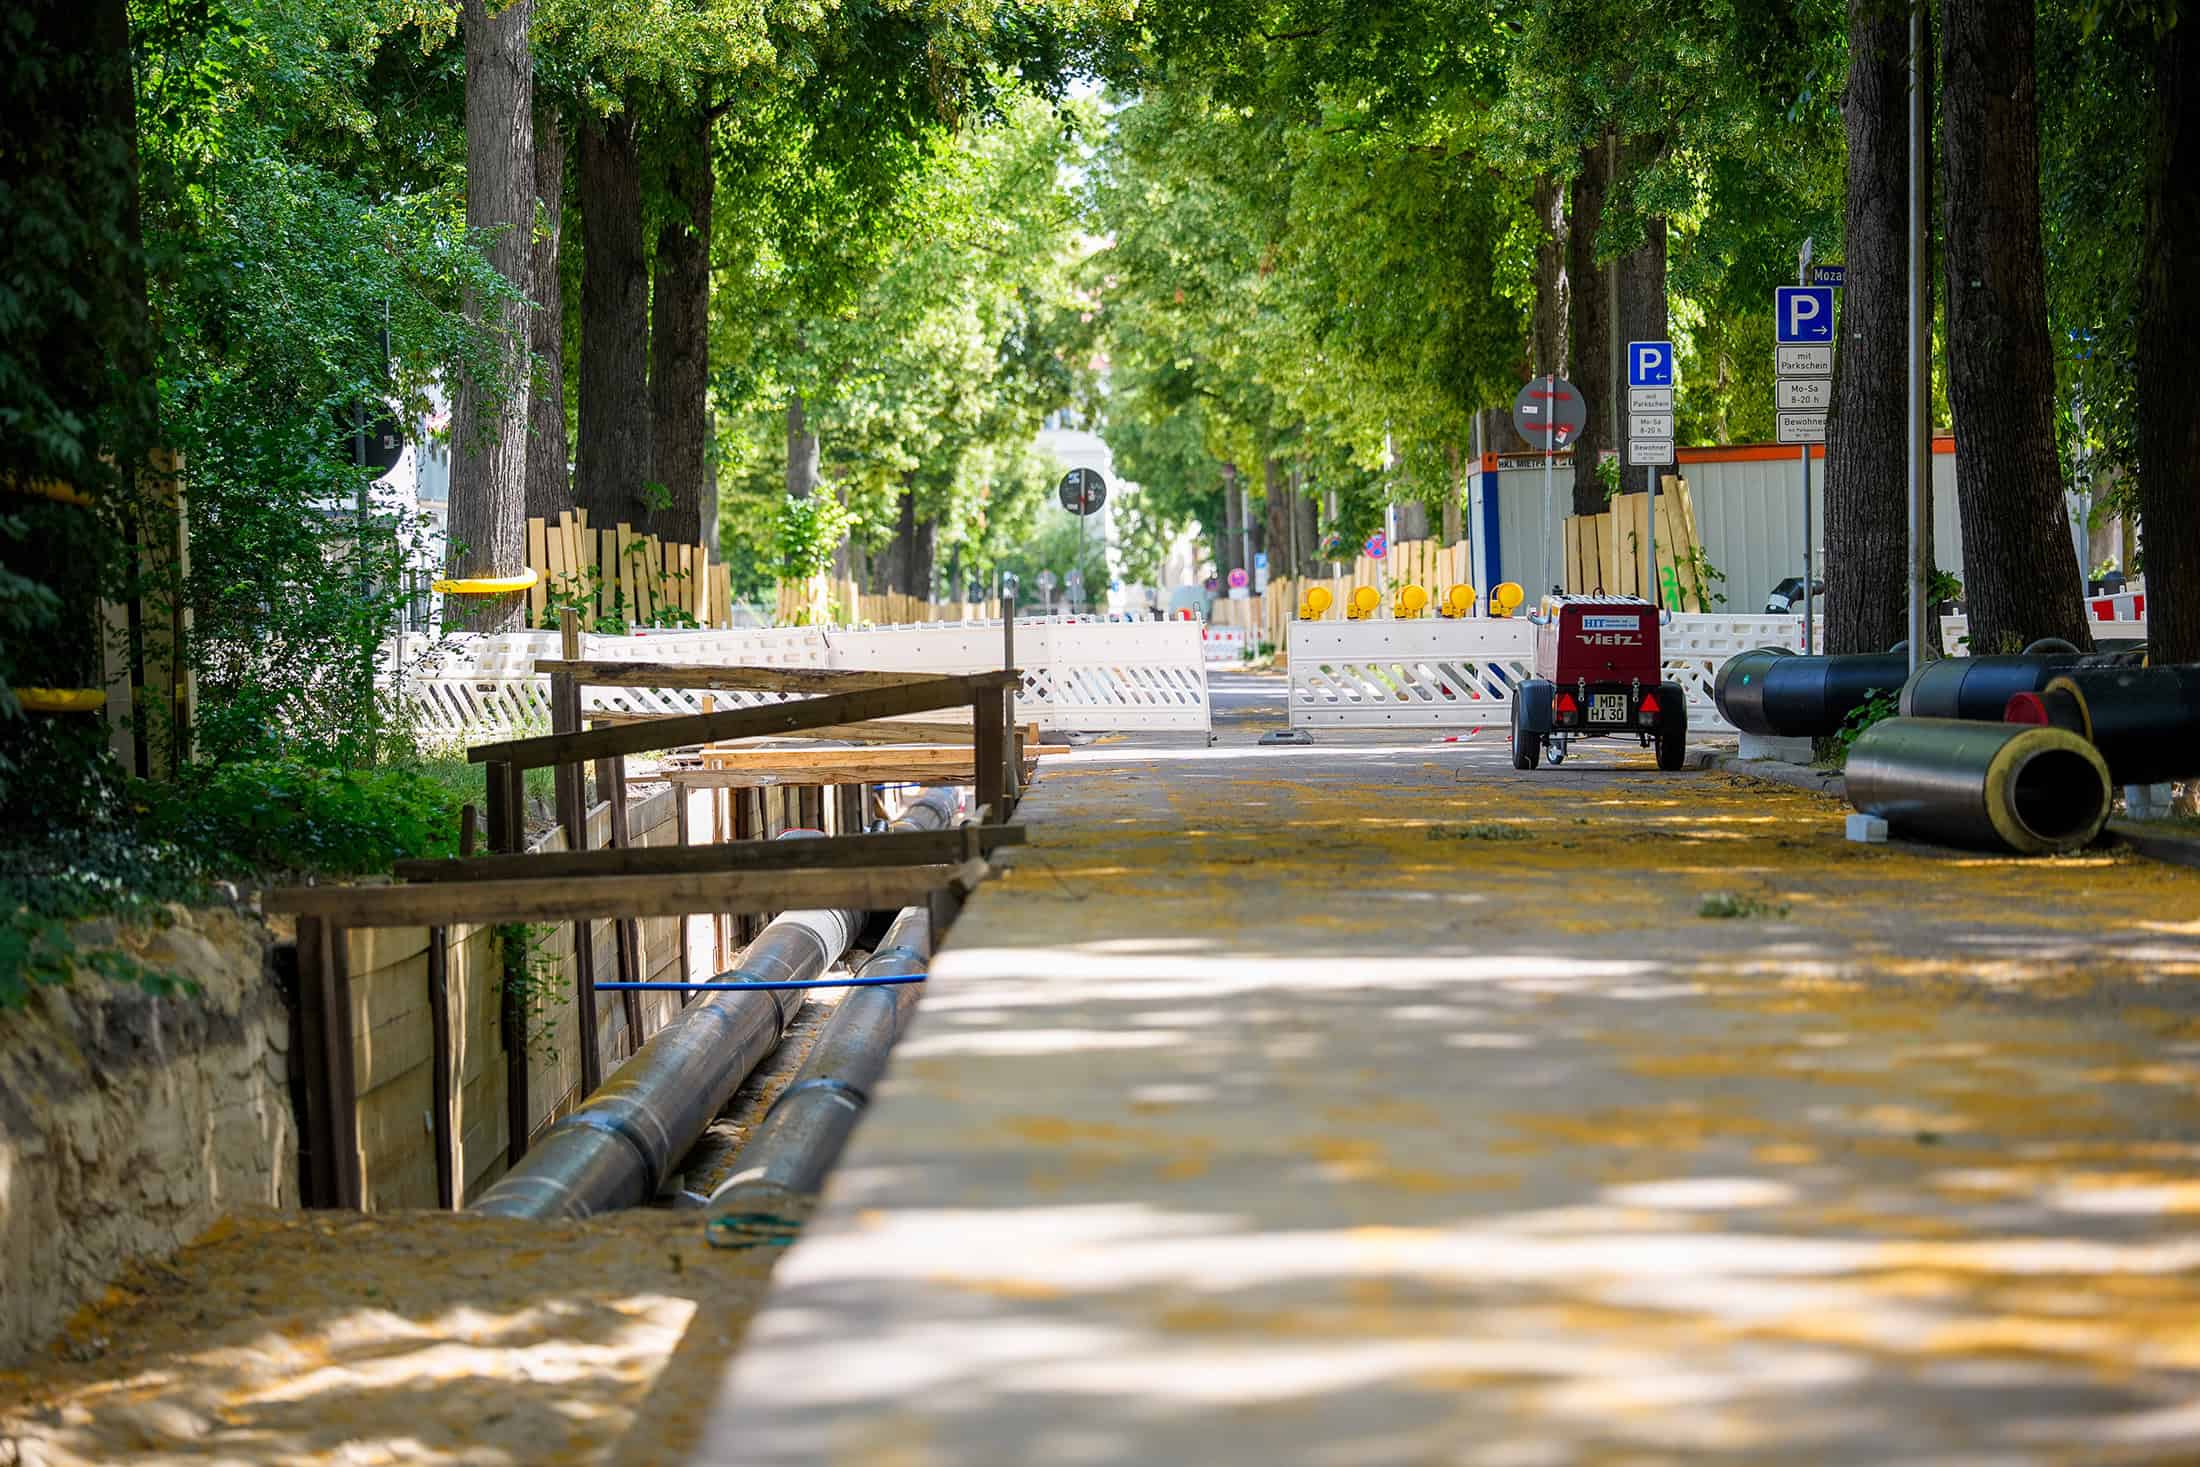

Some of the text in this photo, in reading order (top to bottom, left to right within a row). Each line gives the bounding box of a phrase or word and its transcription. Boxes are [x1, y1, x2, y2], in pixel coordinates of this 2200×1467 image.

[1791, 295, 1820, 336] P
[1797, 352, 1811, 360] mit
[1639, 348, 1662, 381] P
[1781, 361, 1828, 369] Parkschein
[1791, 385, 1819, 393] Mo-Sa
[1600, 695, 1616, 708] MD
[1609, 709, 1624, 721] 30
